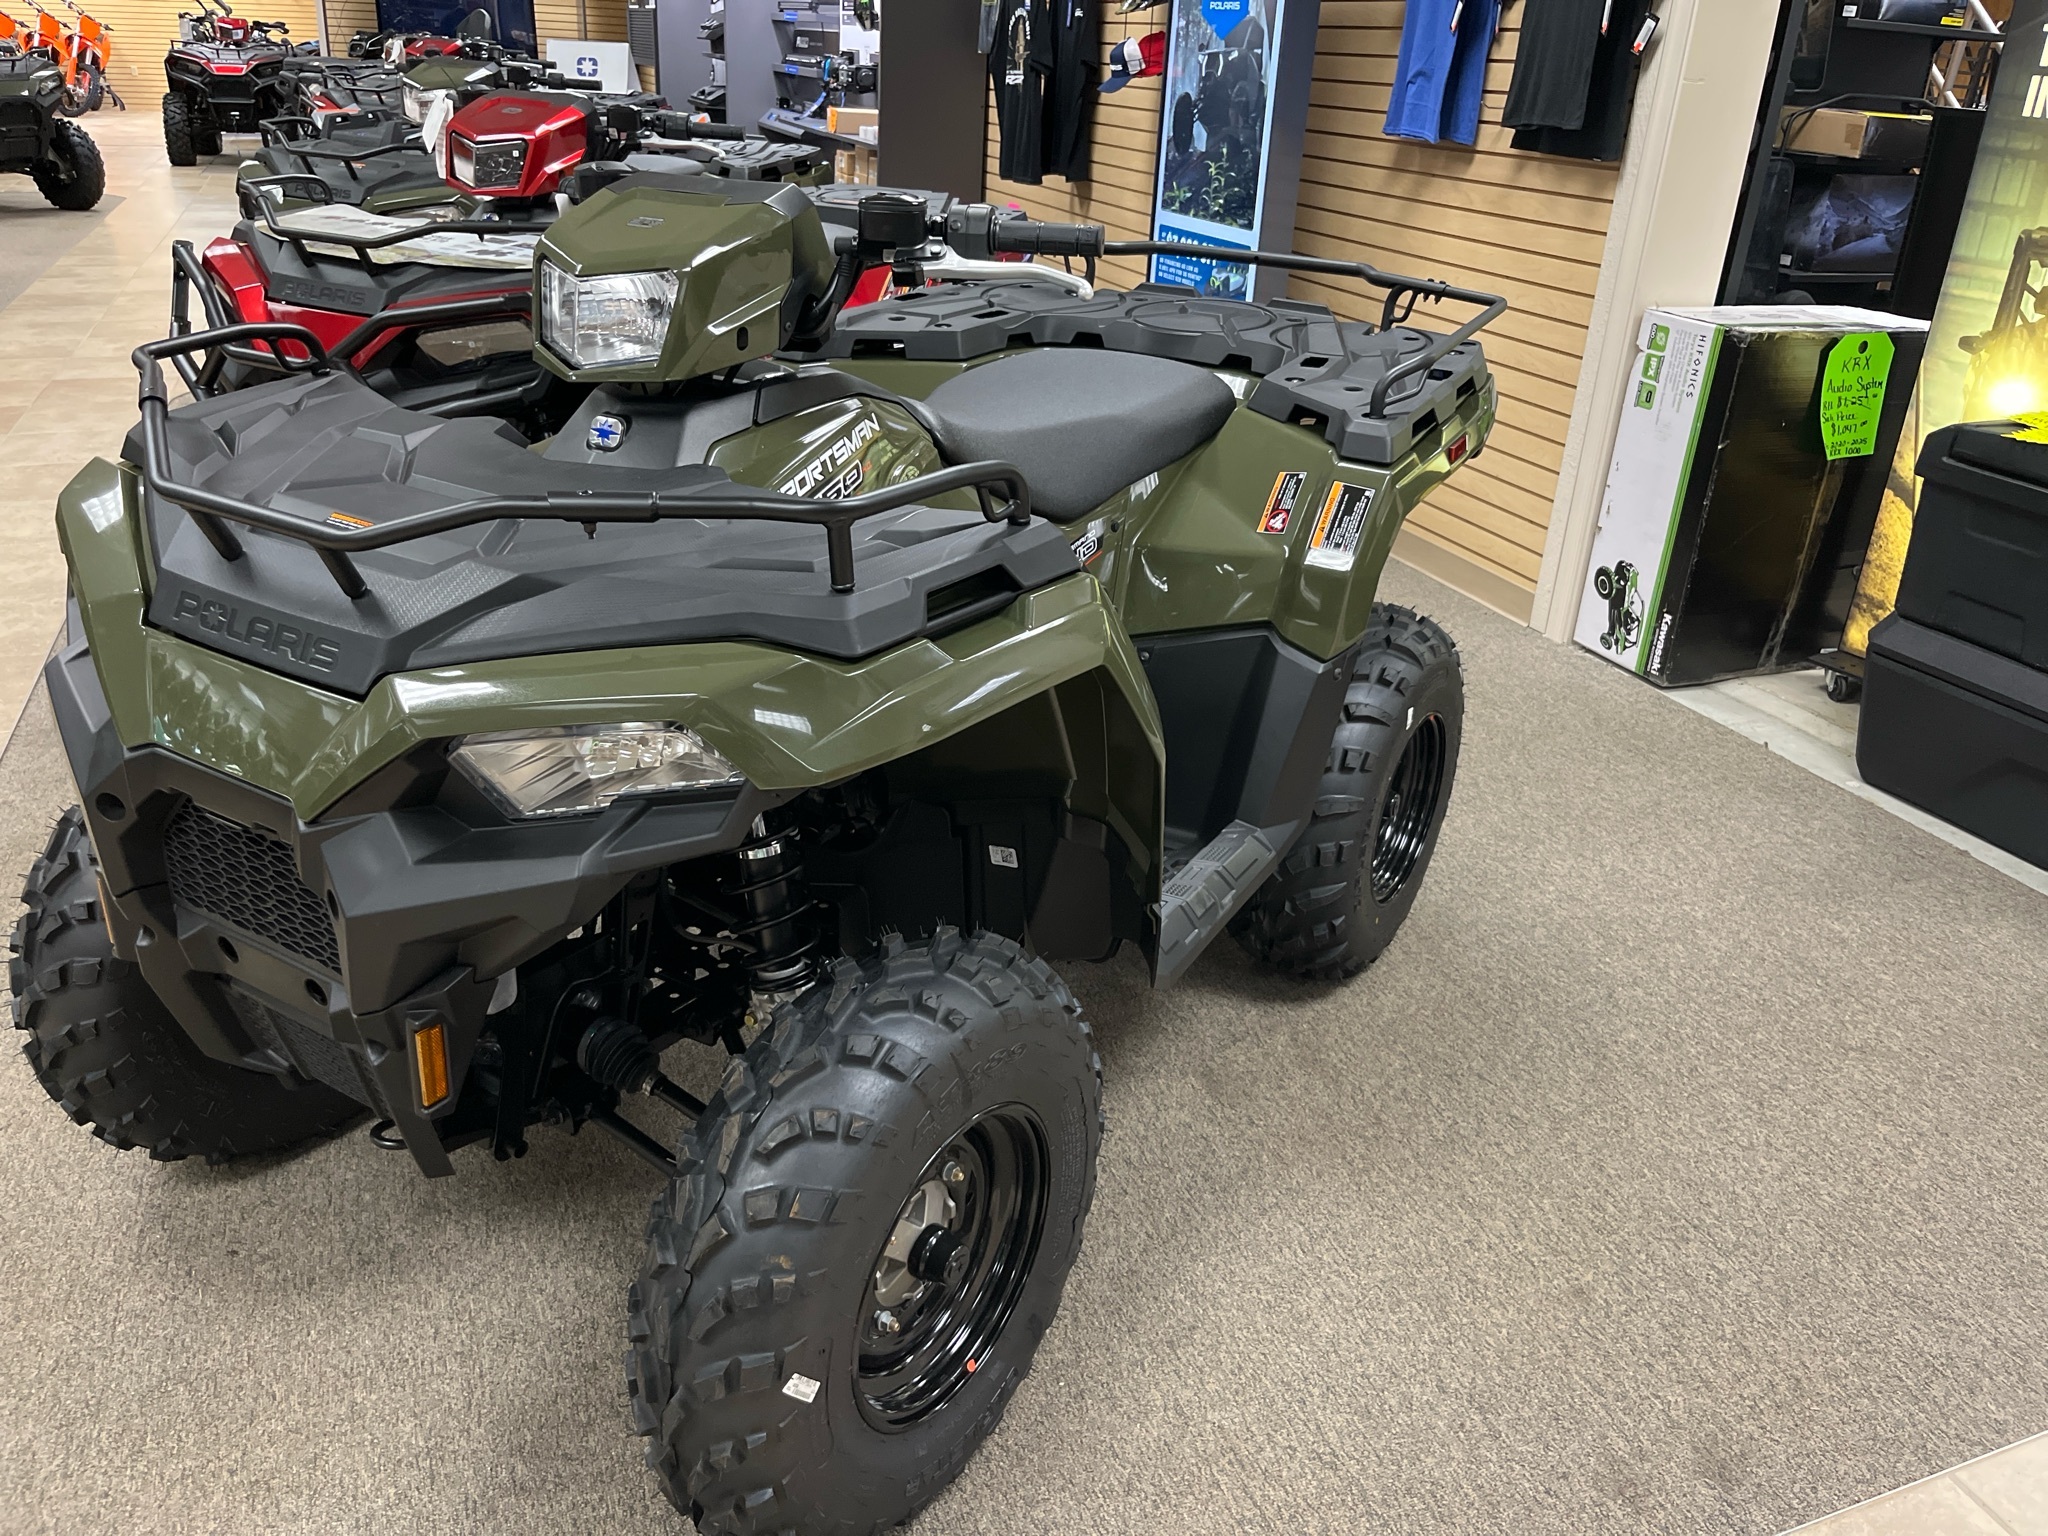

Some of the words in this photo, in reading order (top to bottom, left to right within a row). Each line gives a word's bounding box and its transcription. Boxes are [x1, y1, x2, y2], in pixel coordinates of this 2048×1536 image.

[1209, 1, 1241, 11] POLARIS
[1686, 334, 1707, 399] HIFONICS
[1841, 354, 1872, 373] KRX
[1827, 378, 1853, 393] Audio
[1856, 375, 1884, 398] System
[778, 413, 881, 497] PORTSMAN
[1321, 497, 1335, 525] WARNING
[172, 590, 342, 673] POLARIS
[1650, 613, 1673, 676] Kawasaki
